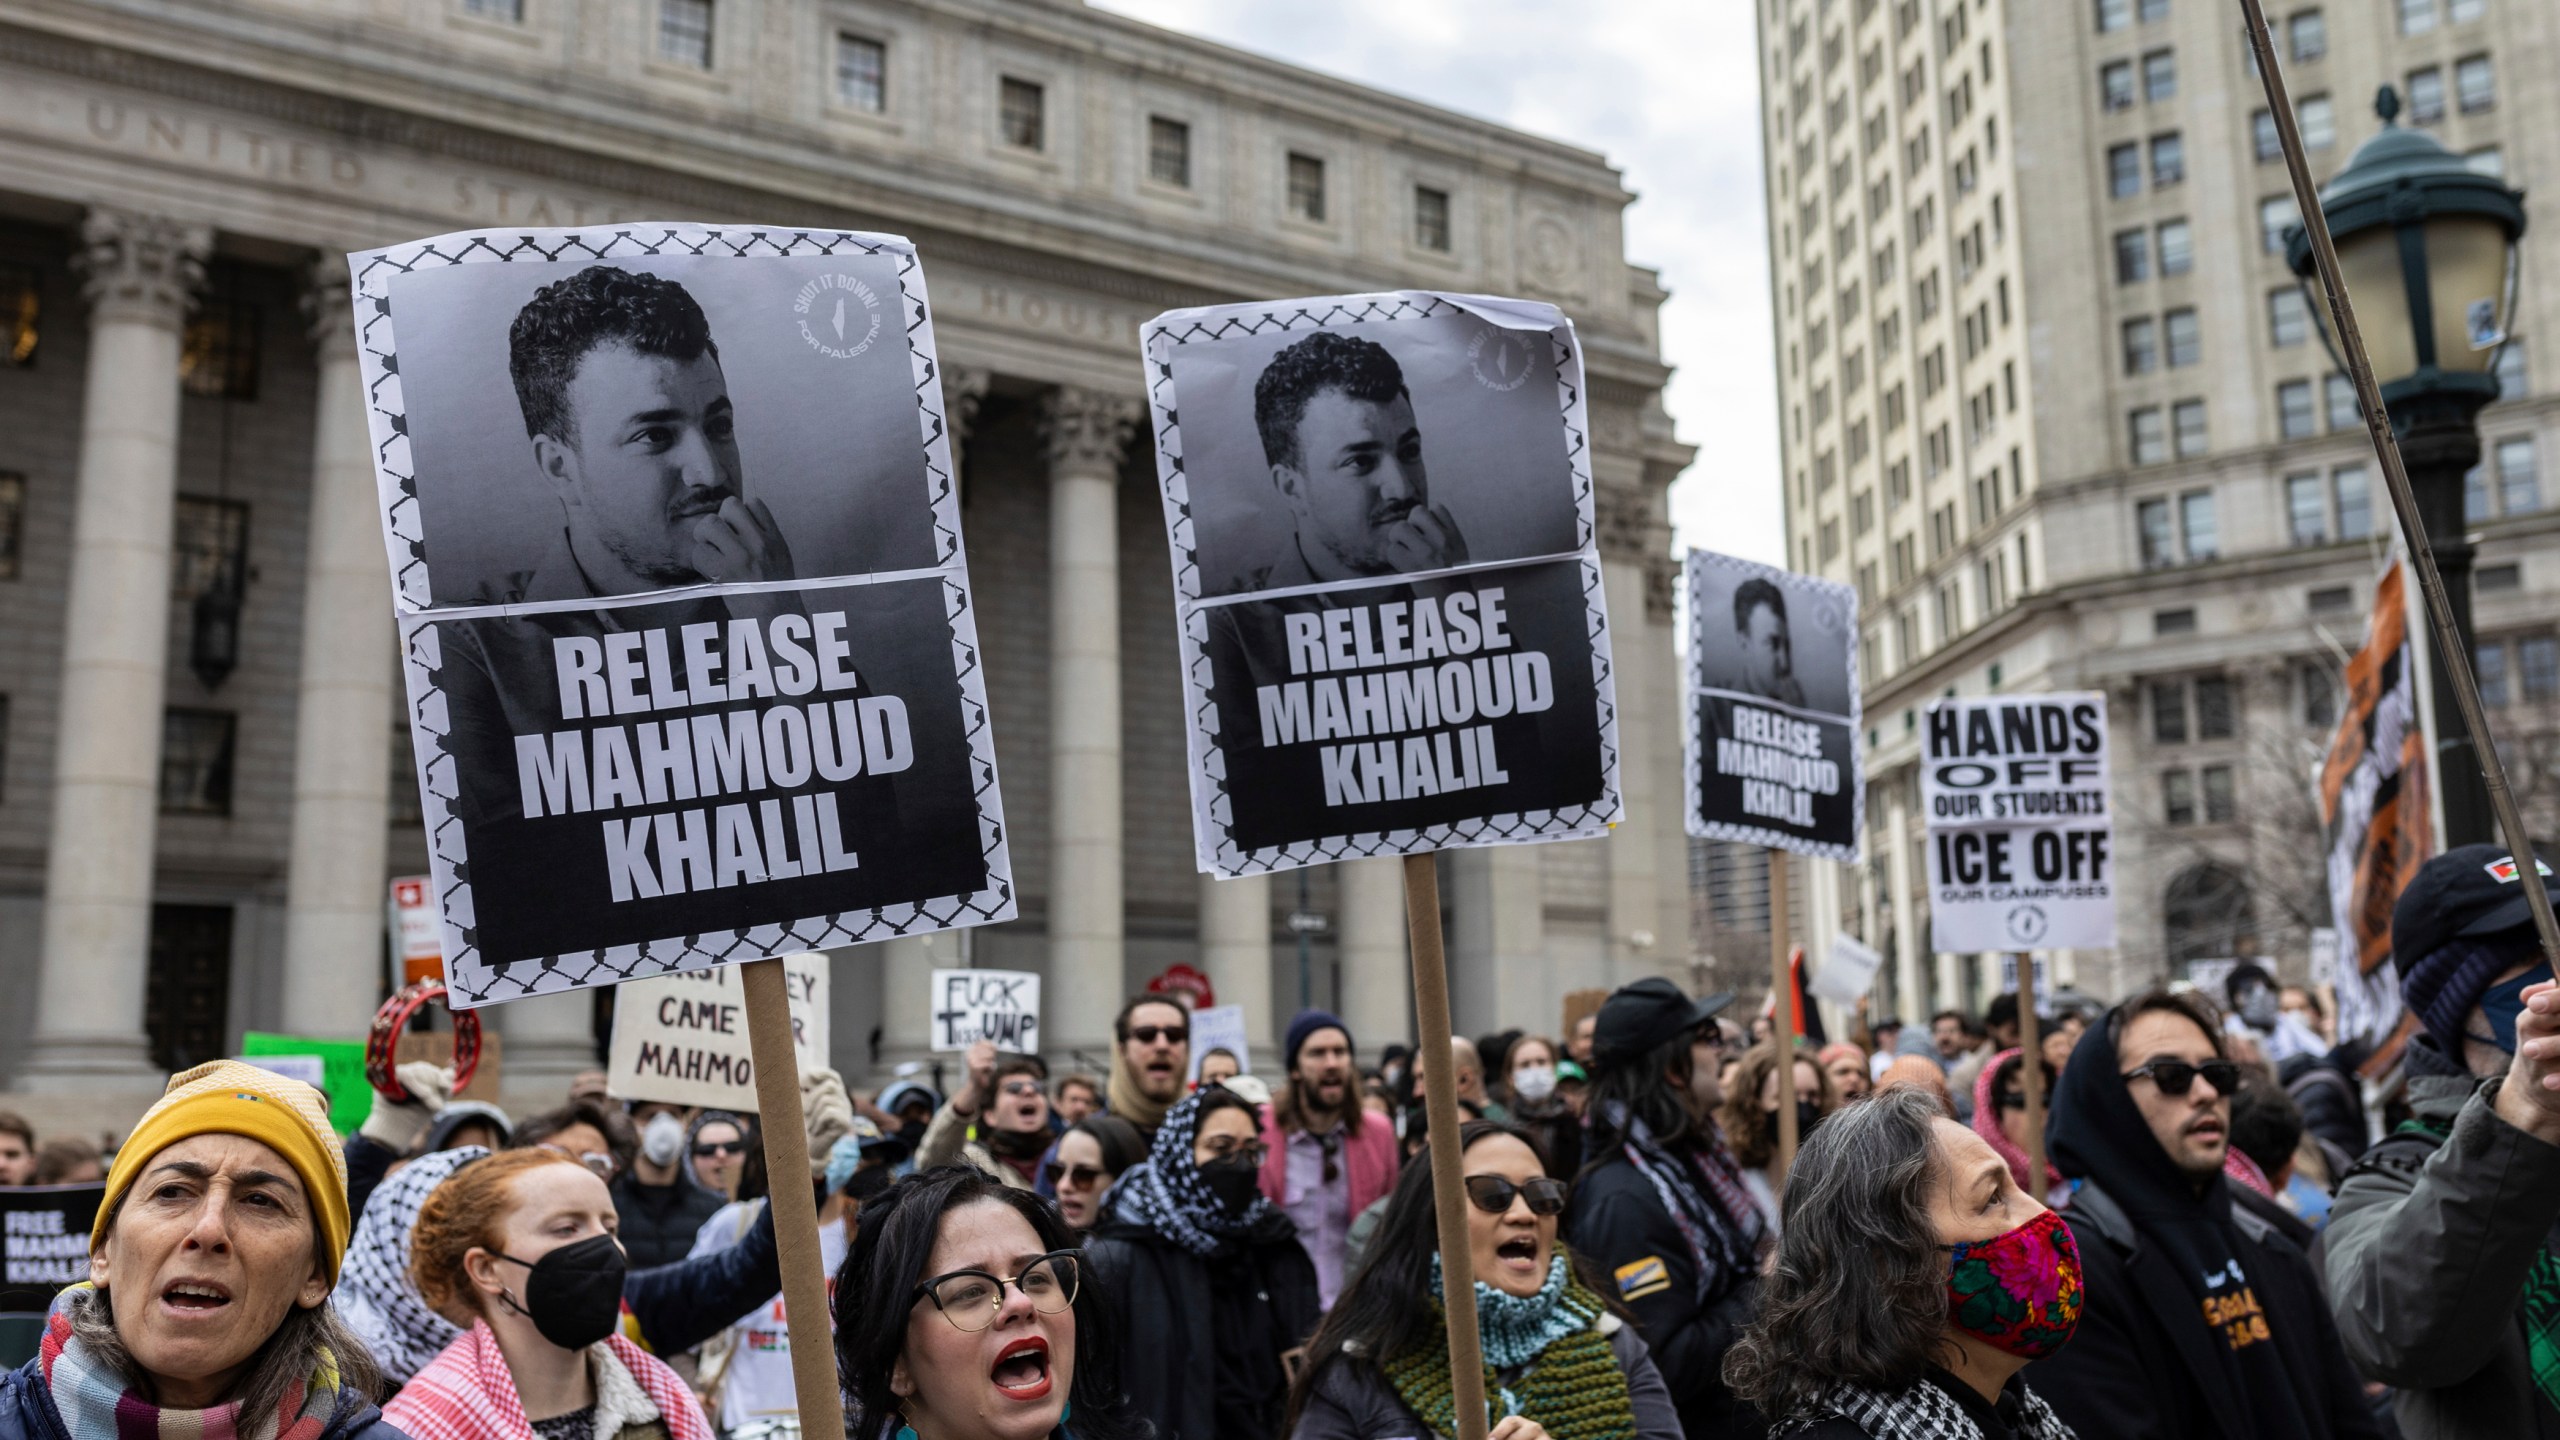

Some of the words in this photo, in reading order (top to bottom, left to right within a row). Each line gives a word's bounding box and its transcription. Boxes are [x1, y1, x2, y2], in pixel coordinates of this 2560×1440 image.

[86, 101, 365, 189] UNITED
[794, 279, 820, 314] SHUT
[819, 273, 833, 290] IT
[837, 273, 880, 310] DOWN!
[797, 319, 820, 350] FOR
[820, 313, 881, 359] PALESTINE
[1284, 587, 1512, 675] RELEASE
[552, 611, 857, 720] RELEASE
[1256, 651, 1554, 747] MAHMOUD
[1929, 704, 2100, 758] HANDS
[514, 694, 914, 819] MAHMOUD
[1320, 724, 1509, 807] KHALIL
[1935, 760, 2099, 788] OFF
[1935, 795, 1982, 817] OUR
[1992, 791, 2104, 817] STUDENTS
[602, 792, 859, 903] KHALIL
[1937, 832, 2013, 886] ICE
[2032, 830, 2108, 882] OFF
[1941, 888, 1984, 902] OUR
[1989, 885, 2110, 902] CAMPUSES
[658, 995, 739, 1035] CAME
[947, 977, 1025, 1010] FUCK
[5, 1211, 65, 1235] FREE
[5, 1233, 91, 1258] MAHM
